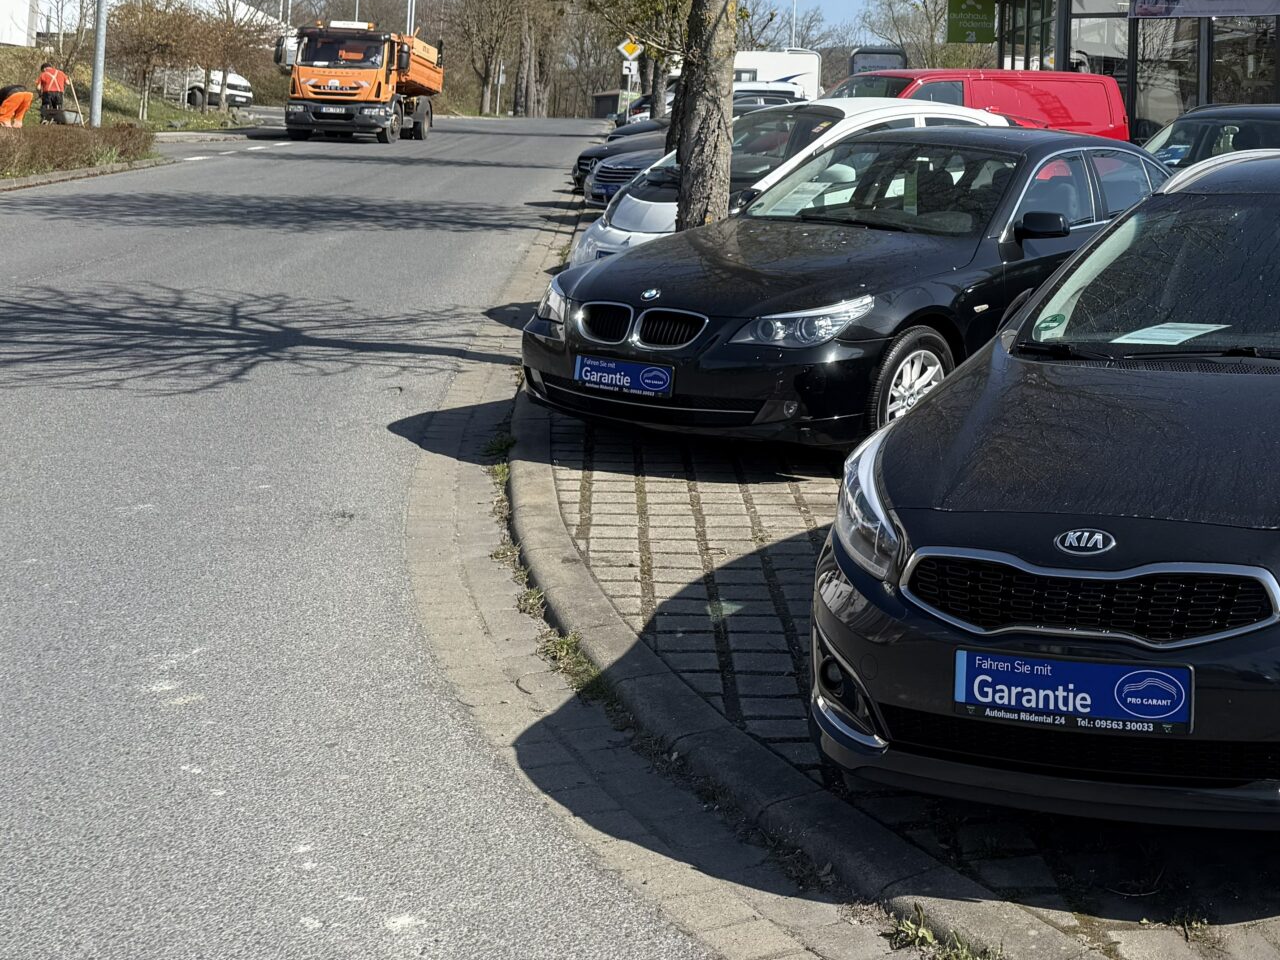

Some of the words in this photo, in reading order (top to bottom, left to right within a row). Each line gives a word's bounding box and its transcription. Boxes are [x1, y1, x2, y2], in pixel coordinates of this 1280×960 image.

[600, 360, 608, 368] Sie
[581, 367, 631, 386] Garantie
[1064, 531, 1104, 548] KIA
[975, 656, 1011, 672] Fahren
[1014, 660, 1031, 674] Sie
[1034, 662, 1052, 676] mit
[973, 674, 1092, 714] Garantie
[1127, 696, 1142, 705] PRO
[1142, 697, 1172, 707] GARANT
[984, 708, 1019, 720] Autohaus
[1020, 710, 1054, 724] Rödental
[1054, 715, 1066, 725] 24
[1076, 717, 1094, 728] Tel.:
[1095, 719, 1124, 730] 09563
[1125, 720, 1154, 732] 30033
